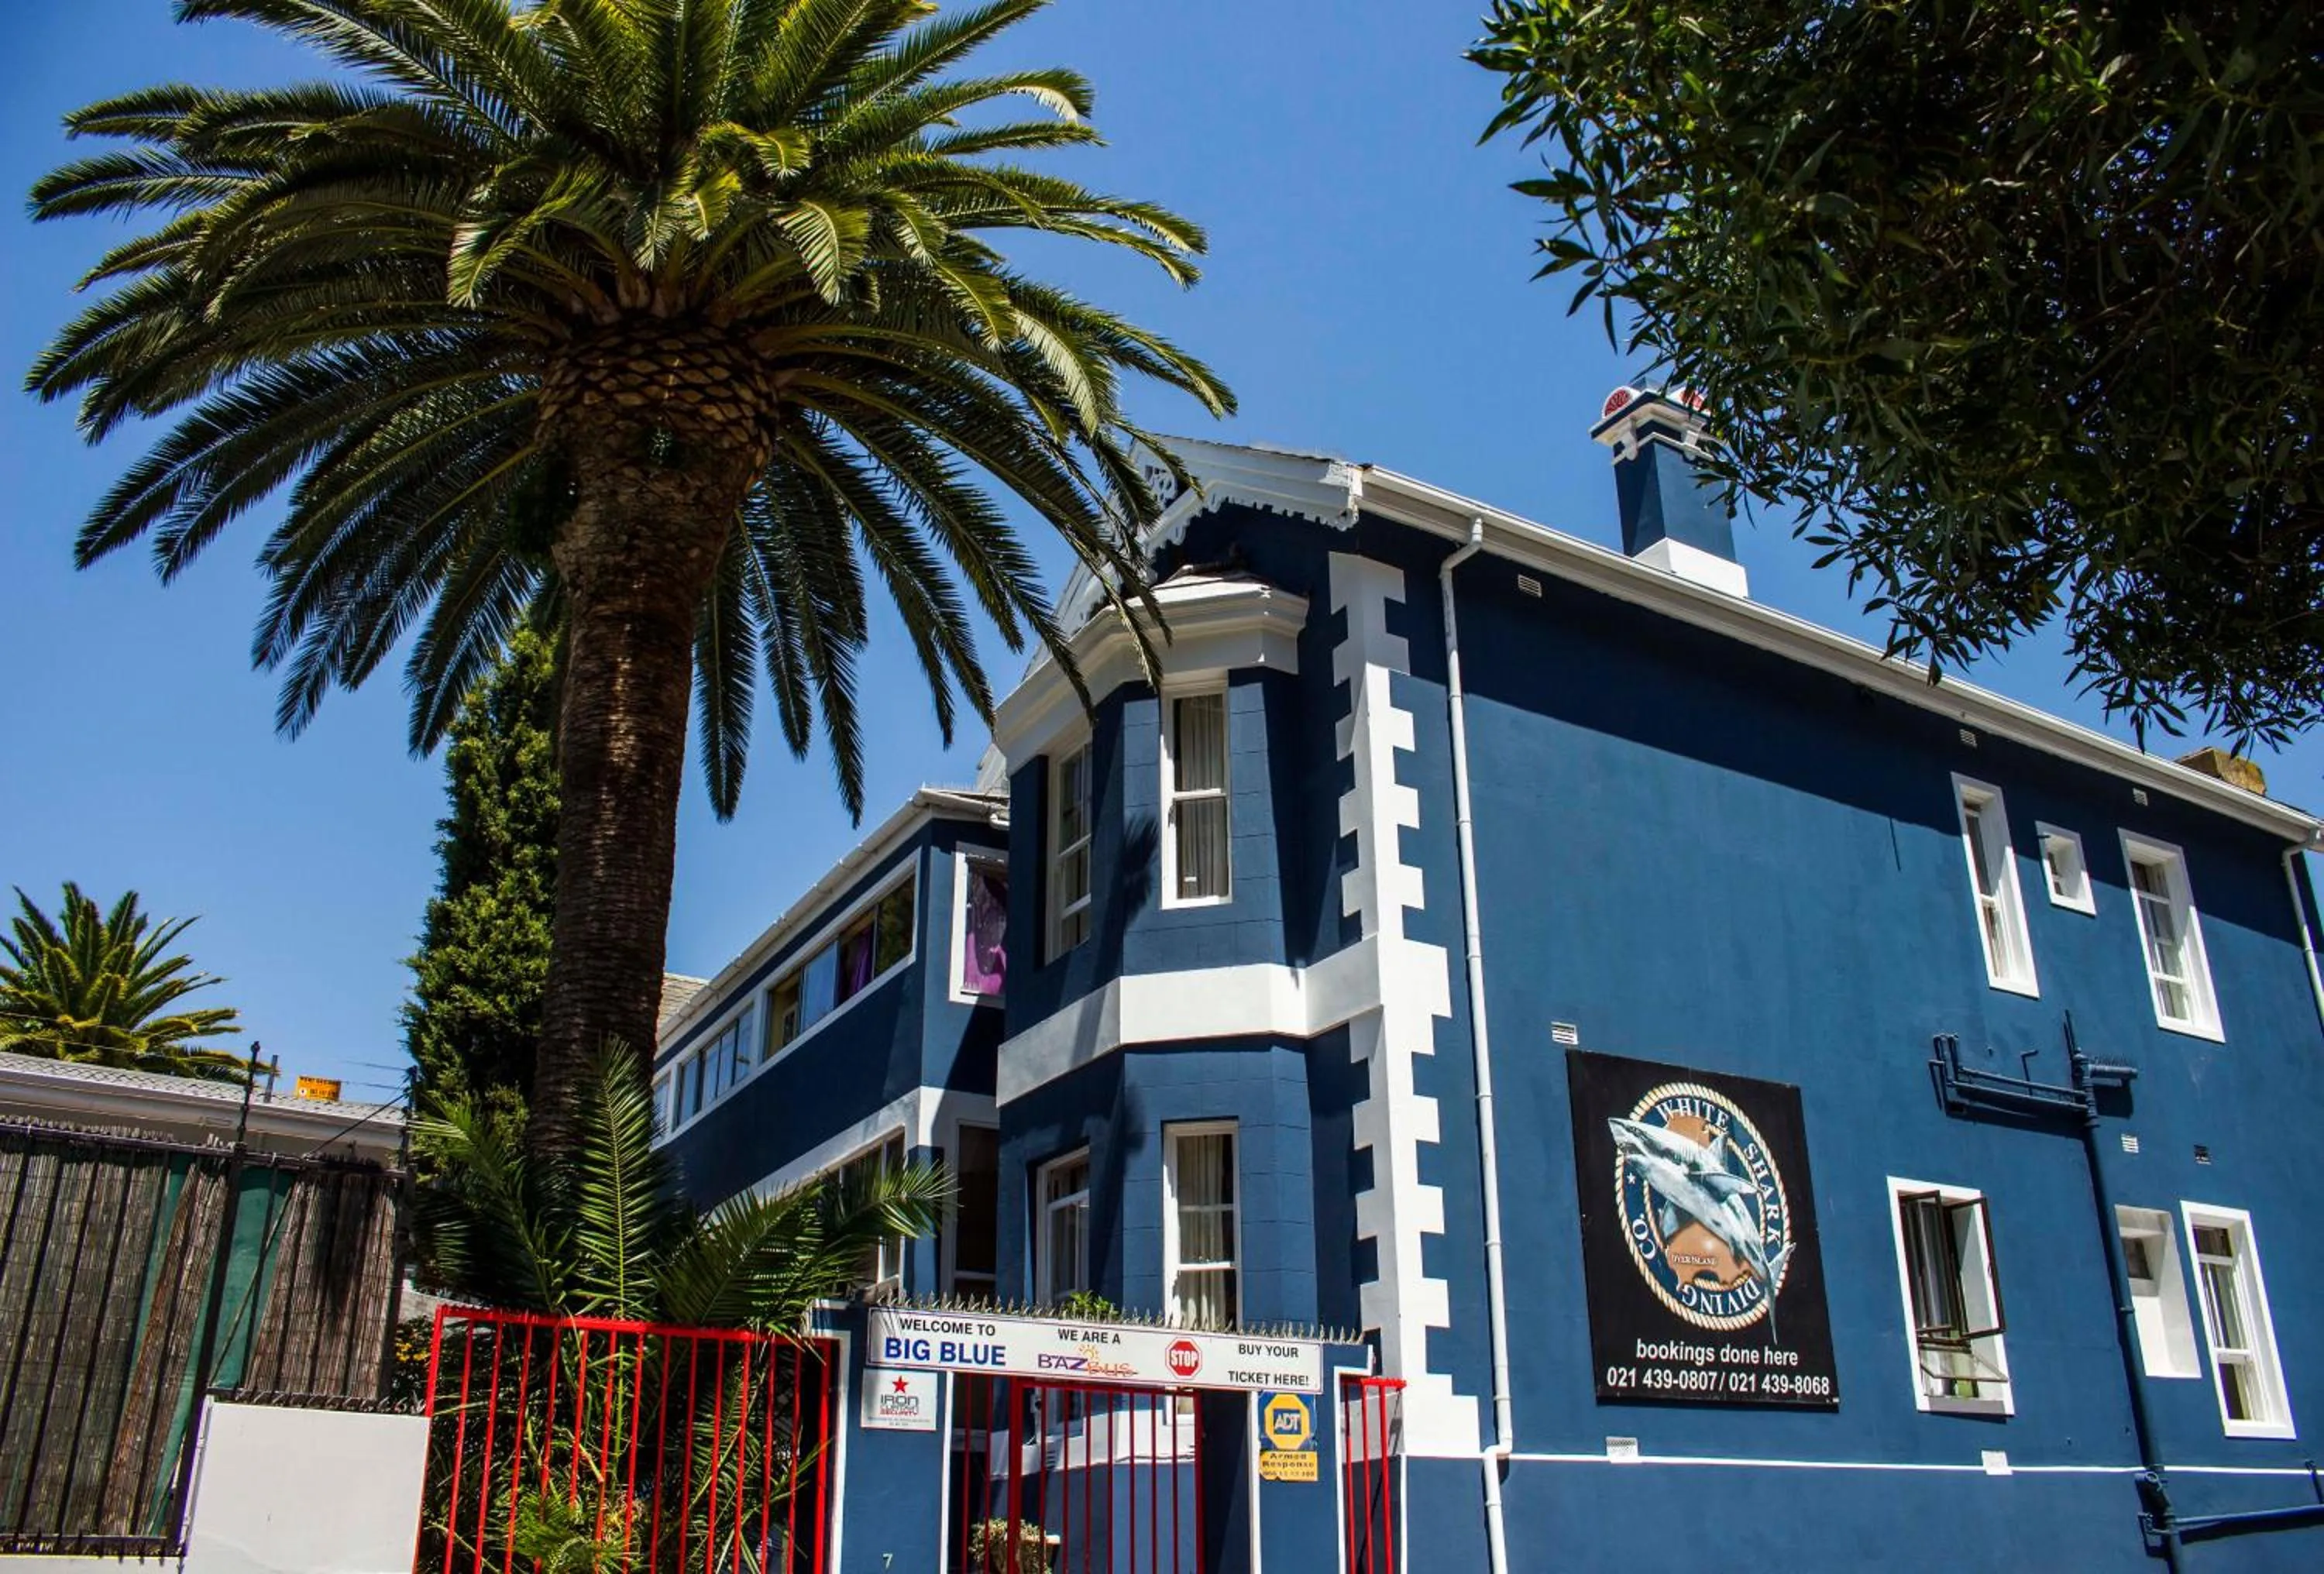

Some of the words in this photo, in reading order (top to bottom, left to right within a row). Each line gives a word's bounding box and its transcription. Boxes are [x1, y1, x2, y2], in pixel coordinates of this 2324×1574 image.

[1655, 1098, 1729, 1132] WHITE
[1744, 1143, 1781, 1249] SHARK
[1682, 1277, 1760, 1315] DIVING
[900, 1318, 972, 1334] WELCOME
[978, 1324, 995, 1336] TO
[1058, 1328, 1078, 1341] WE
[1081, 1331, 1108, 1343] ARE
[1112, 1333, 1121, 1344] A
[885, 1337, 930, 1360] BIG
[940, 1341, 1006, 1366] BLUE
[1171, 1349, 1198, 1367] STOP
[1239, 1344, 1261, 1356] BUY
[1267, 1345, 1299, 1358] YOUR
[1636, 1339, 1714, 1366] bookings
[1720, 1343, 1759, 1363] done
[1764, 1345, 1798, 1366] here
[1038, 1354, 1088, 1370] BAZ
[1228, 1370, 1270, 1384] TICKET
[1274, 1373, 1309, 1386] HERE!
[1607, 1366, 1636, 1387] 021
[1729, 1373, 1755, 1392] 021
[1761, 1374, 1830, 1395] 439-8068
[1274, 1413, 1301, 1431] ADT
[1262, 1460, 1315, 1469] Response
[883, 1553, 893, 1569] 7
